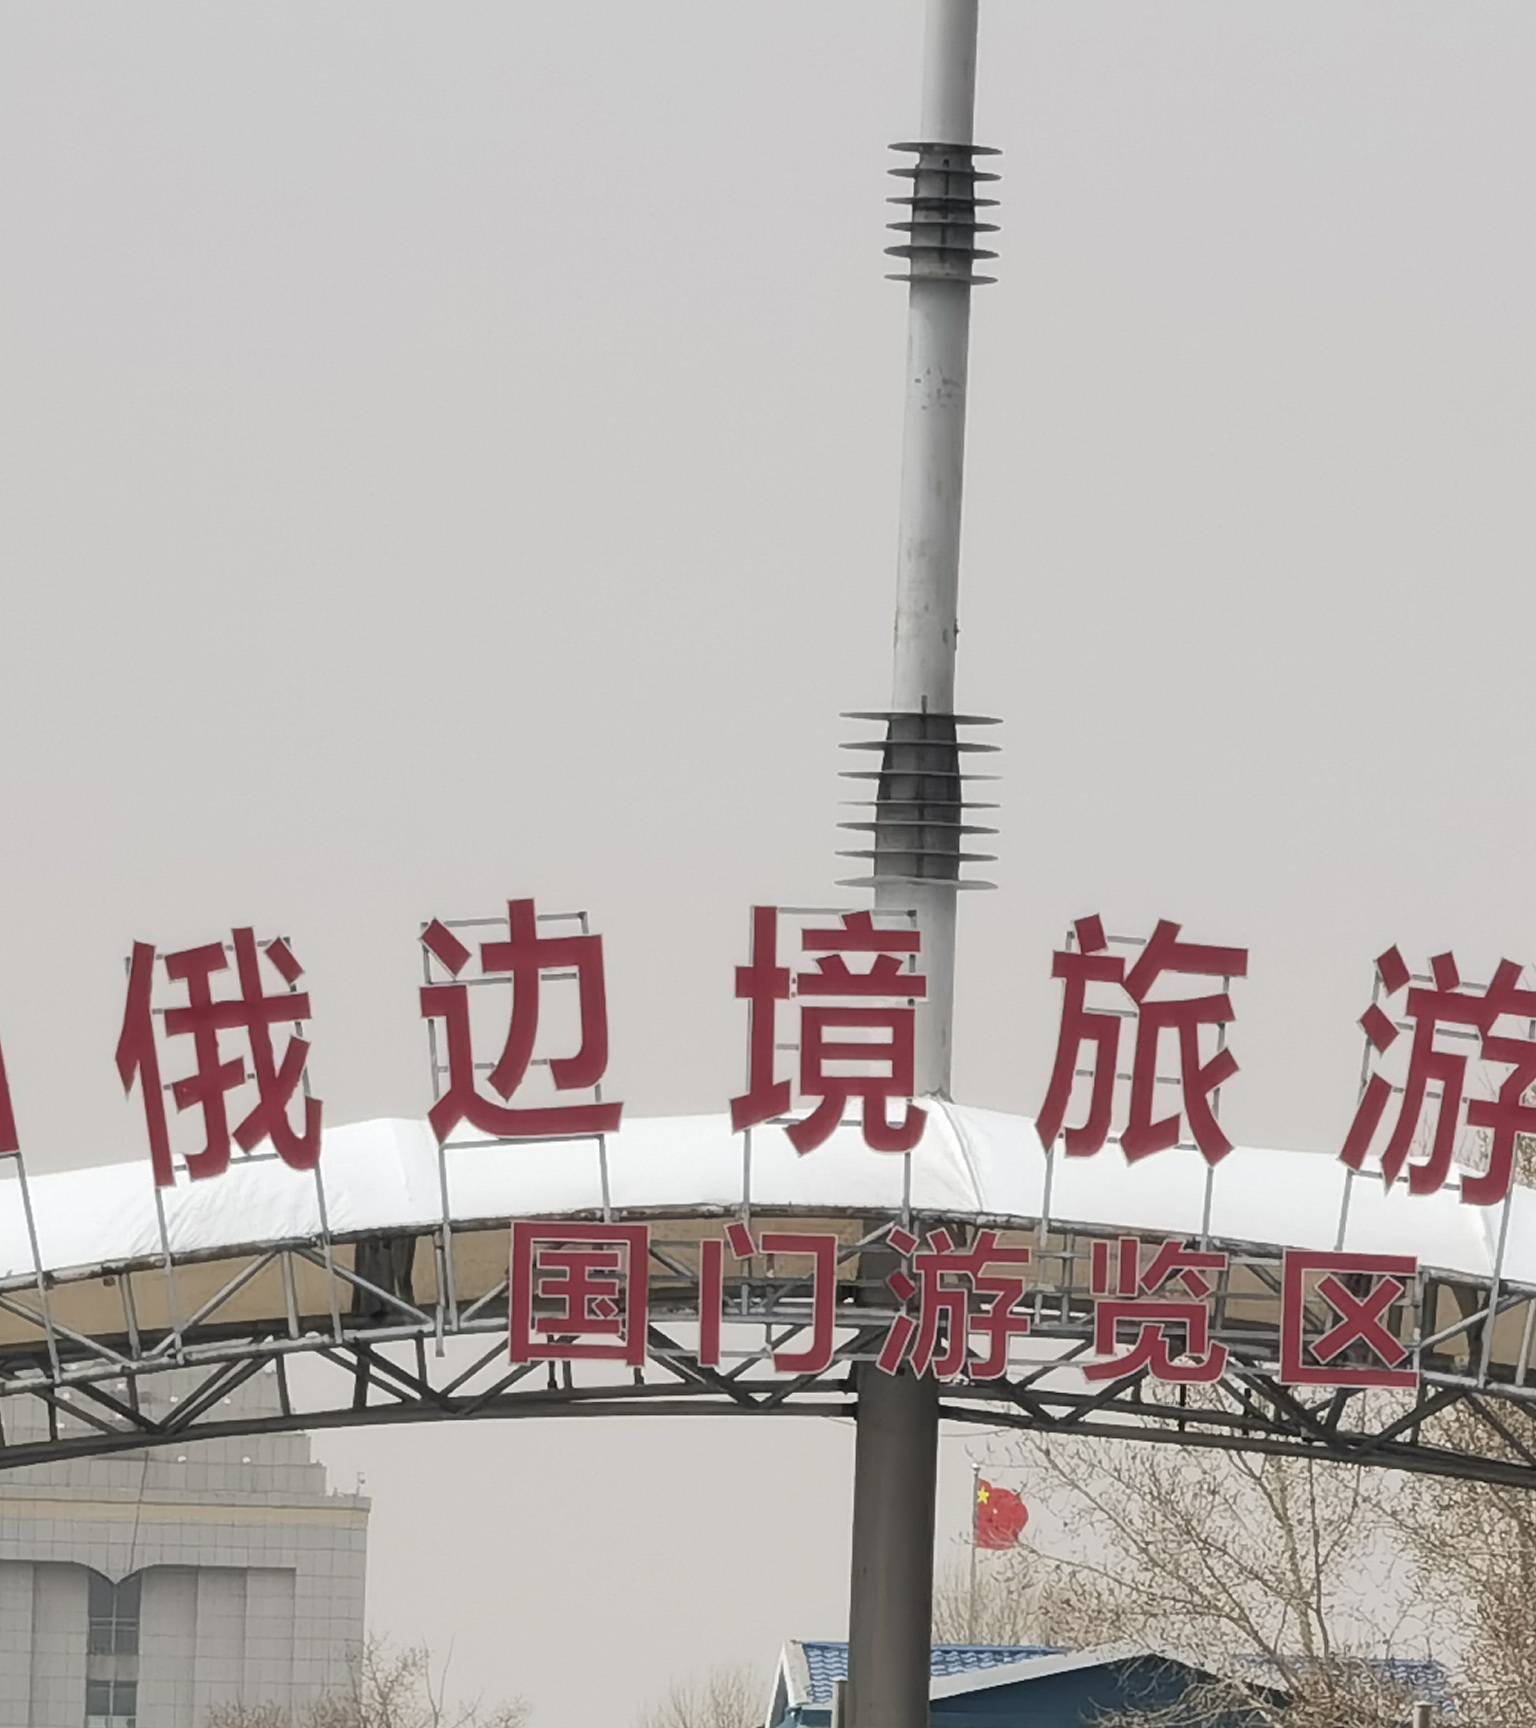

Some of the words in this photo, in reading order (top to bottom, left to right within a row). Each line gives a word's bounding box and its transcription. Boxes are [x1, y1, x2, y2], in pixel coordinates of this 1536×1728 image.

[508, 1222, 1419, 1388] 国门游览区
